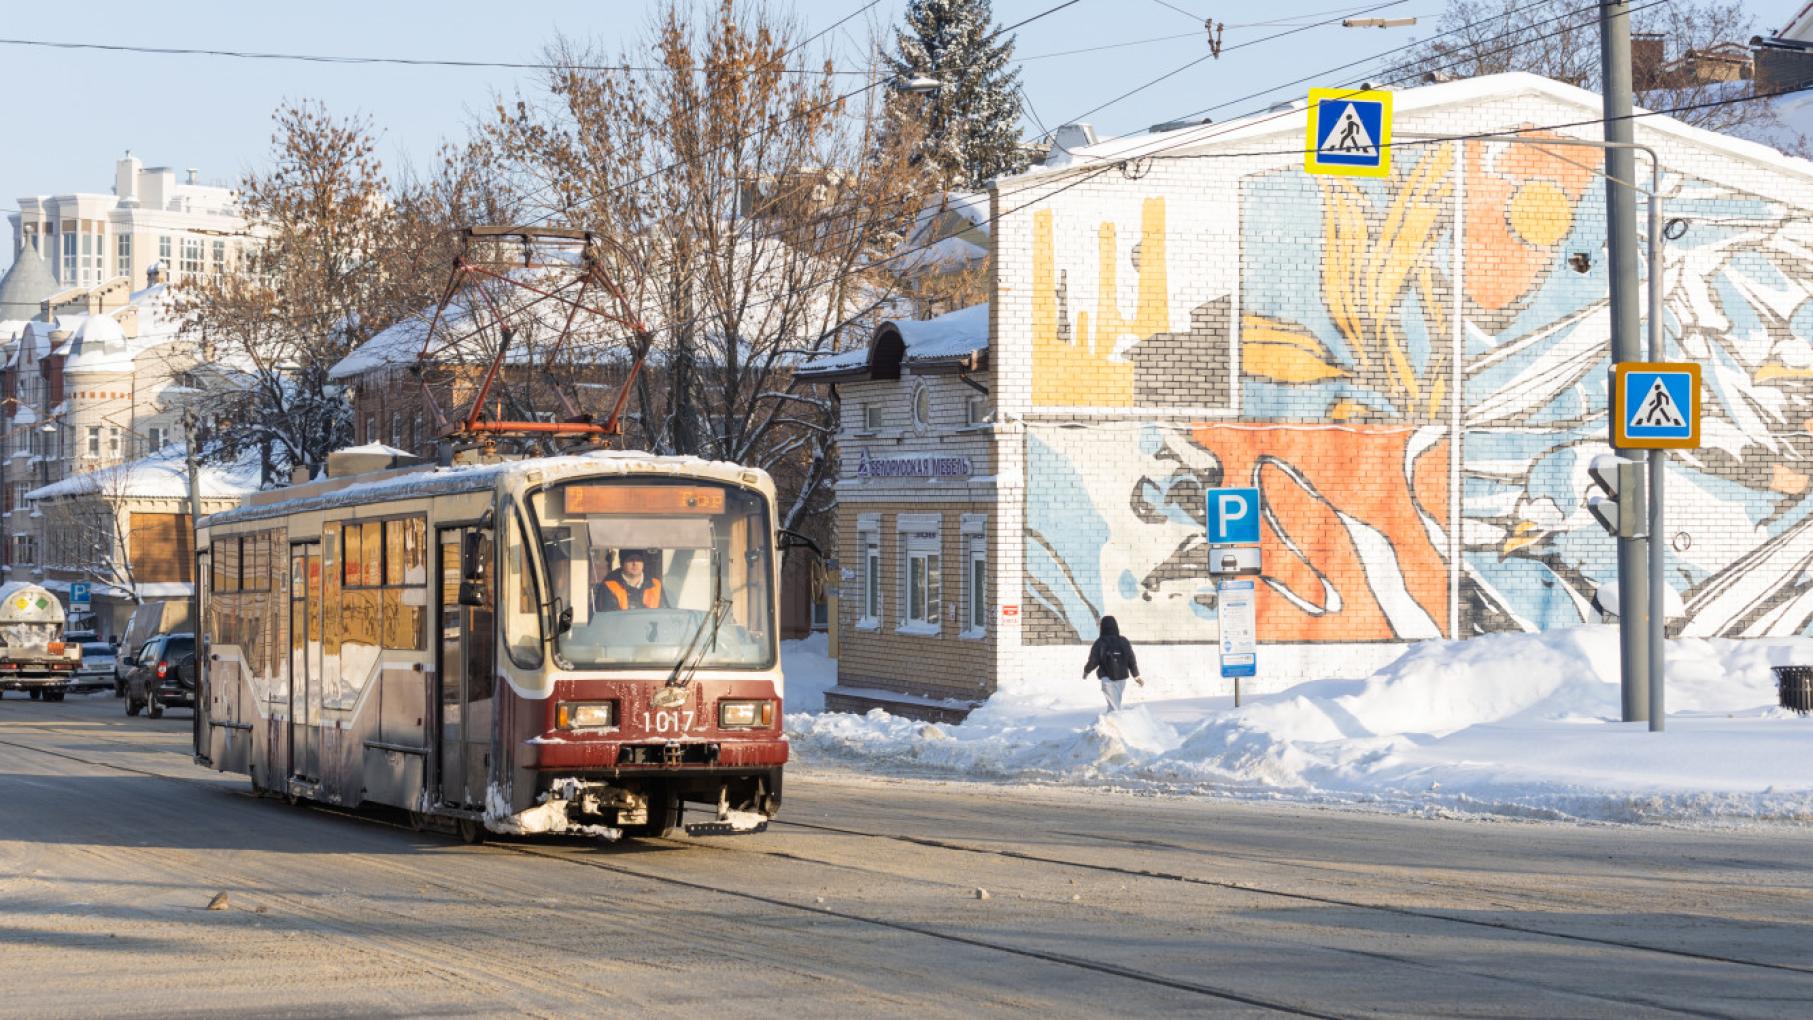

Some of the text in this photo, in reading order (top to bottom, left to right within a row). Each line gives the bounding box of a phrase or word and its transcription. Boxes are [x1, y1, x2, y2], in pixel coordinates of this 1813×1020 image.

[870, 457, 968, 476] БЕЛОРУССКАЯ МЕБЕЛЬ
[1219, 495, 1247, 537] P
[75, 585, 86, 600] P
[643, 711, 694, 732] 1017
